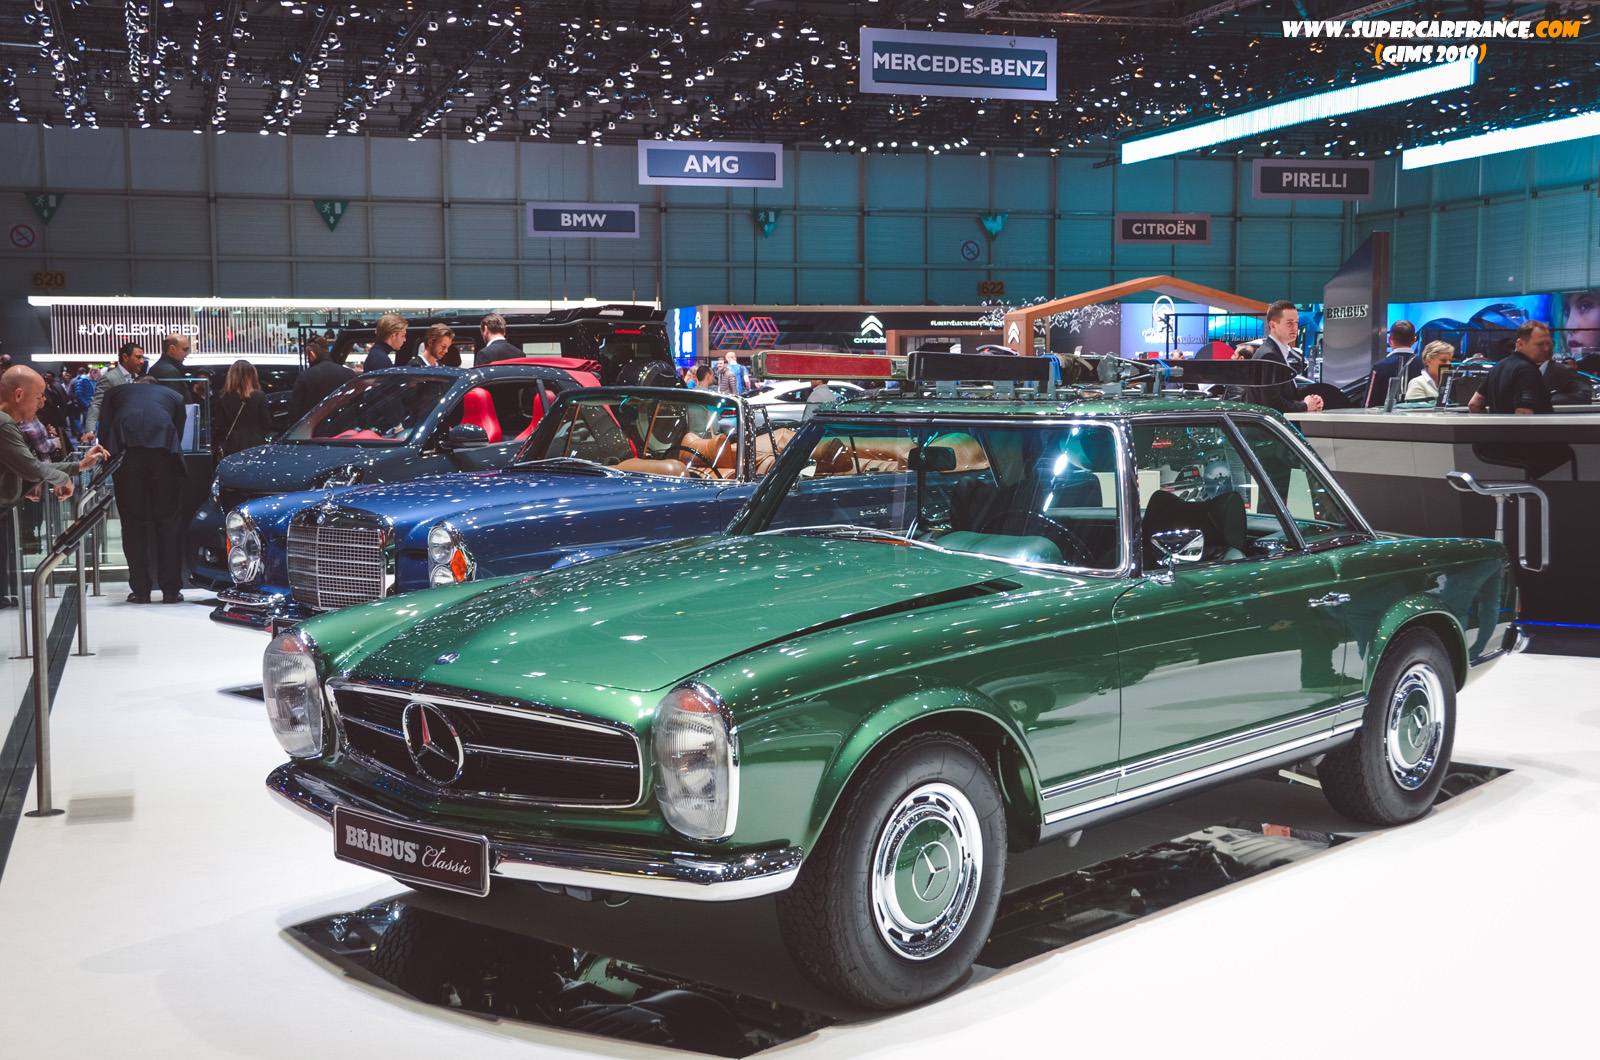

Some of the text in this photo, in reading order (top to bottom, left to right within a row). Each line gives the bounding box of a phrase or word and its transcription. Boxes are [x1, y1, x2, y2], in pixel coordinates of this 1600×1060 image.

[873, 52, 1046, 78] MERCEDES-BENZ
[683, 154, 739, 174] AMG
[1282, 172, 1347, 188] PIRELLI
[560, 213, 607, 227] BMW
[1132, 220, 1196, 236] CITROËN
[33, 272, 65, 287] 620
[981, 281, 1004, 295] 622
[1326, 304, 1367, 320] BRABUS
[421, 845, 472, 875] Classic
